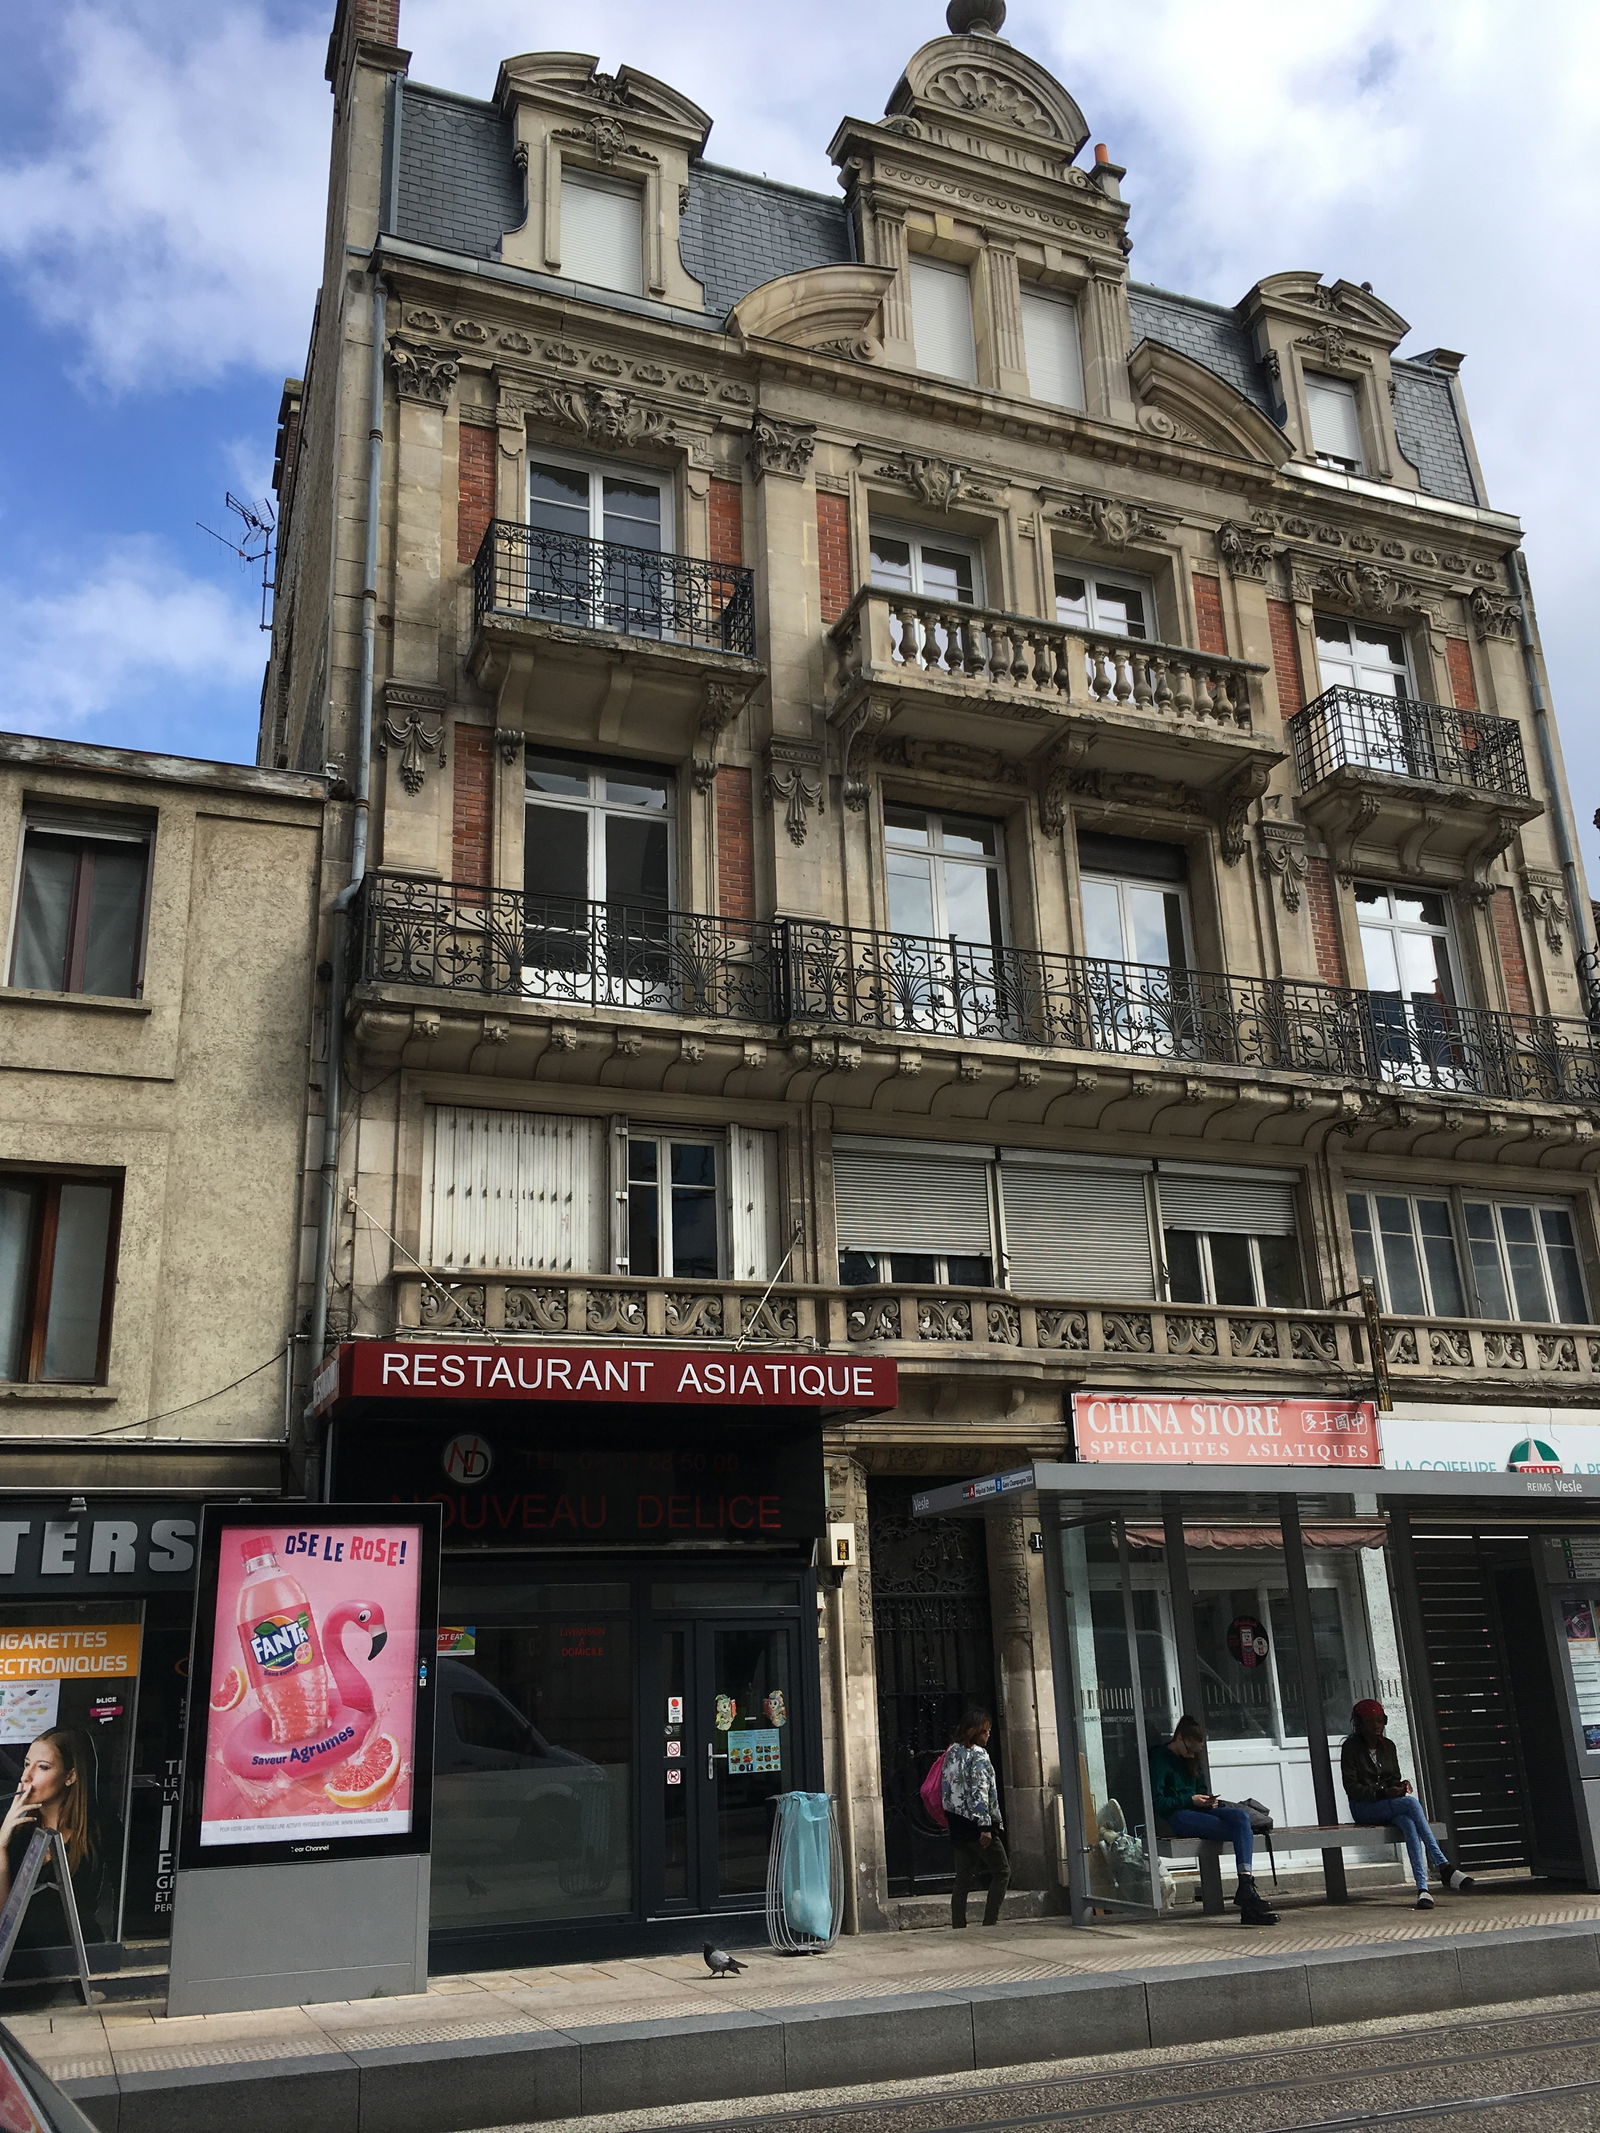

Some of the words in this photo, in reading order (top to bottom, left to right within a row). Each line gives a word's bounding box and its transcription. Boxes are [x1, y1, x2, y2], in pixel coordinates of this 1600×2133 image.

[382, 1353, 654, 1392] RESTAURANT
[677, 1363, 875, 1397] ASIATIQUE
[1087, 1401, 1184, 1435] CHINA
[1190, 1403, 1282, 1437] STORE
[1089, 1440, 1230, 1457] SPECIALITES
[1247, 1443, 1369, 1461] ASIATIQUES
[1527, 1482, 1552, 1492] REIMS
[1555, 1479, 1582, 1493] Vesle
[391, 1494, 609, 1528] OUVEAU
[637, 1495, 782, 1528] DELICE
[913, 1496, 929, 1511] Vesle
[0, 1520, 196, 1575] TERS
[285, 1531, 319, 1557] OSE
[323, 1536, 344, 1562] LE
[349, 1536, 407, 1567] ROSE!
[0, 1632, 107, 1650] IGARETTES
[251, 1622, 309, 1663] FANTA
[252, 1755, 287, 1765] Saveur
[290, 1726, 355, 1763] Agrumes
[164, 1778, 178, 1788] LE
[163, 1790, 180, 1801] LA
[305, 1844, 329, 1852] Channel
[157, 1853, 174, 1873] E
[155, 1891, 170, 1903] ET
